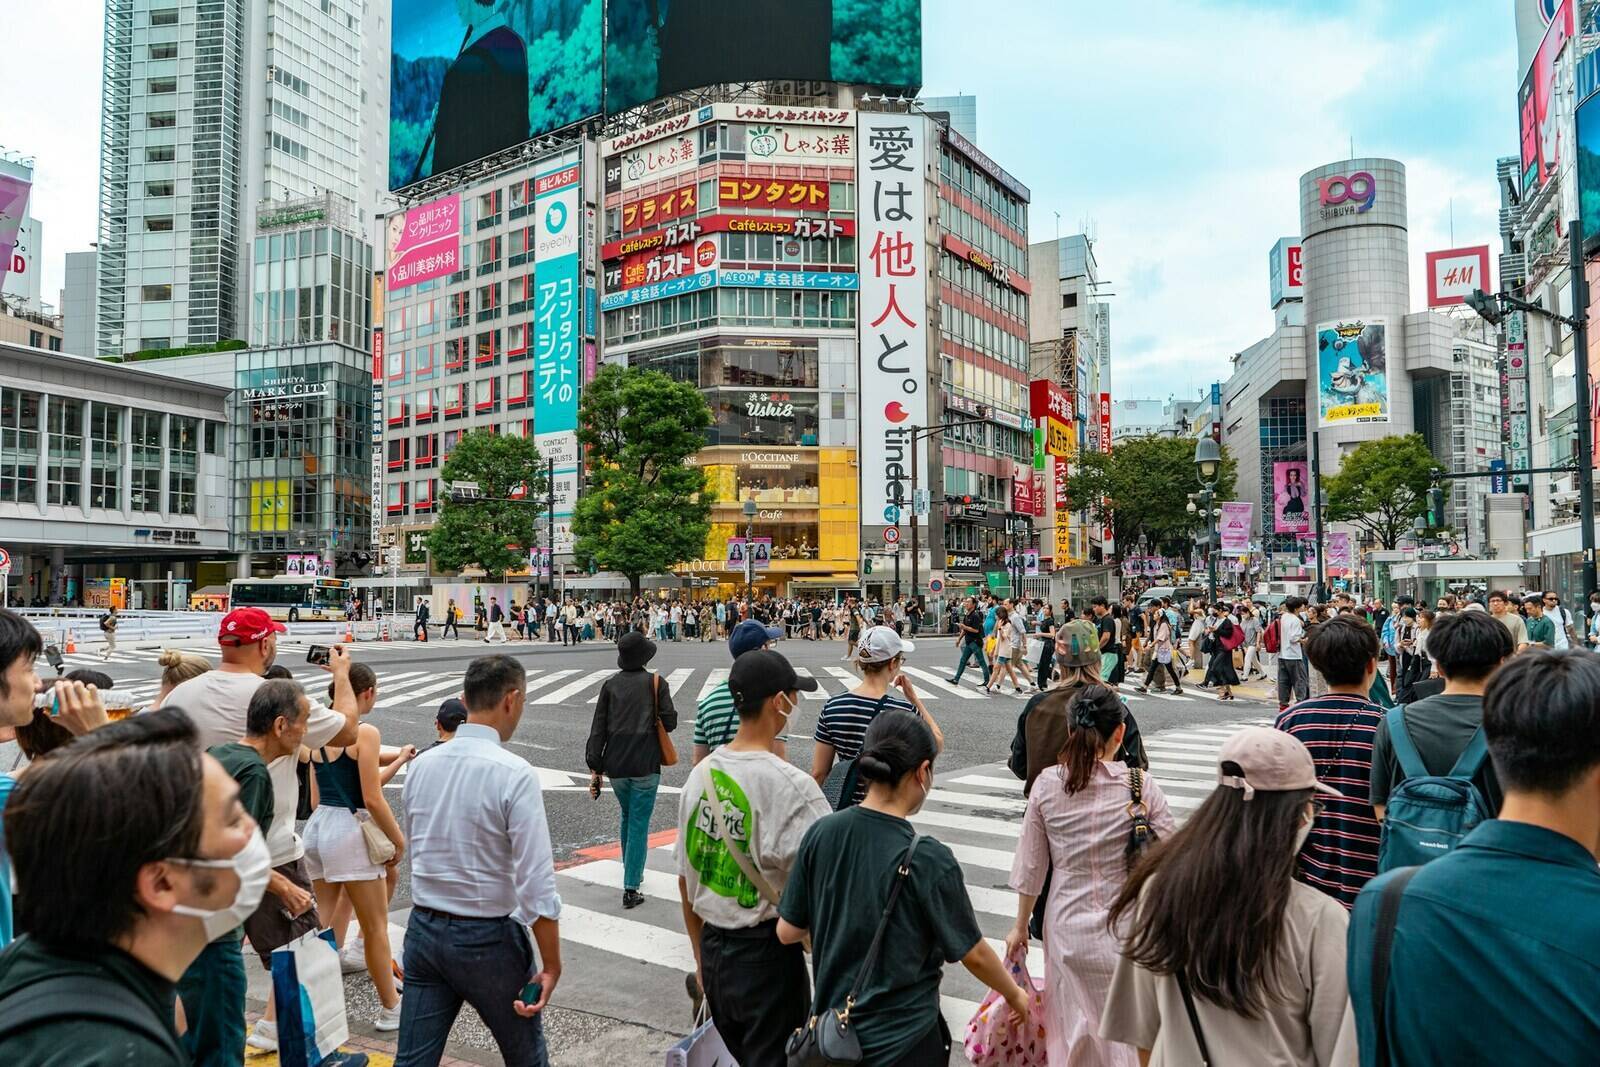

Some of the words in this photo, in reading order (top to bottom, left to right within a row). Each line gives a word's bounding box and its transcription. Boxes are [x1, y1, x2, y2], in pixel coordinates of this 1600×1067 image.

[736, 105, 849, 123] しゃぶしゃぶバイキング
[612, 114, 691, 150] しゃぶしゃぶバイキング
[648, 139, 693, 170] しゃぶ葉
[783, 132, 850, 155] しゃぶ葉
[538, 169, 575, 192] 当ビル5F
[607, 166, 621, 181] 9F
[719, 181, 826, 204] コンタクト
[418, 203, 456, 225] 品川スキン
[623, 188, 696, 227] プライス
[1320, 206, 1355, 219] SHIBUYA
[418, 218, 453, 240] クリニック
[665, 221, 702, 247] ガスト
[793, 217, 843, 239] ガスト
[539, 234, 573, 252] eyecity
[397, 250, 456, 281] 品川美容外科
[646, 251, 691, 283] ガスト
[868, 126, 917, 394] 愛は他人と。
[606, 269, 622, 286] 7F
[763, 272, 856, 287] 英会話イーオン
[1443, 265, 1474, 287] H&M
[631, 278, 696, 303] 英会話イーオン
[539, 281, 558, 405] アイシティ
[558, 277, 573, 402] コンタクトの
[243, 385, 287, 399] MARK
[292, 383, 330, 394] CITY
[264, 376, 305, 386] SHIBUYA
[543, 437, 569, 447] CONTACT
[549, 447, 562, 455] LENS
[741, 452, 800, 463] L'OCCITANE
[885, 427, 910, 509] tinder
[759, 509, 783, 521] Café
